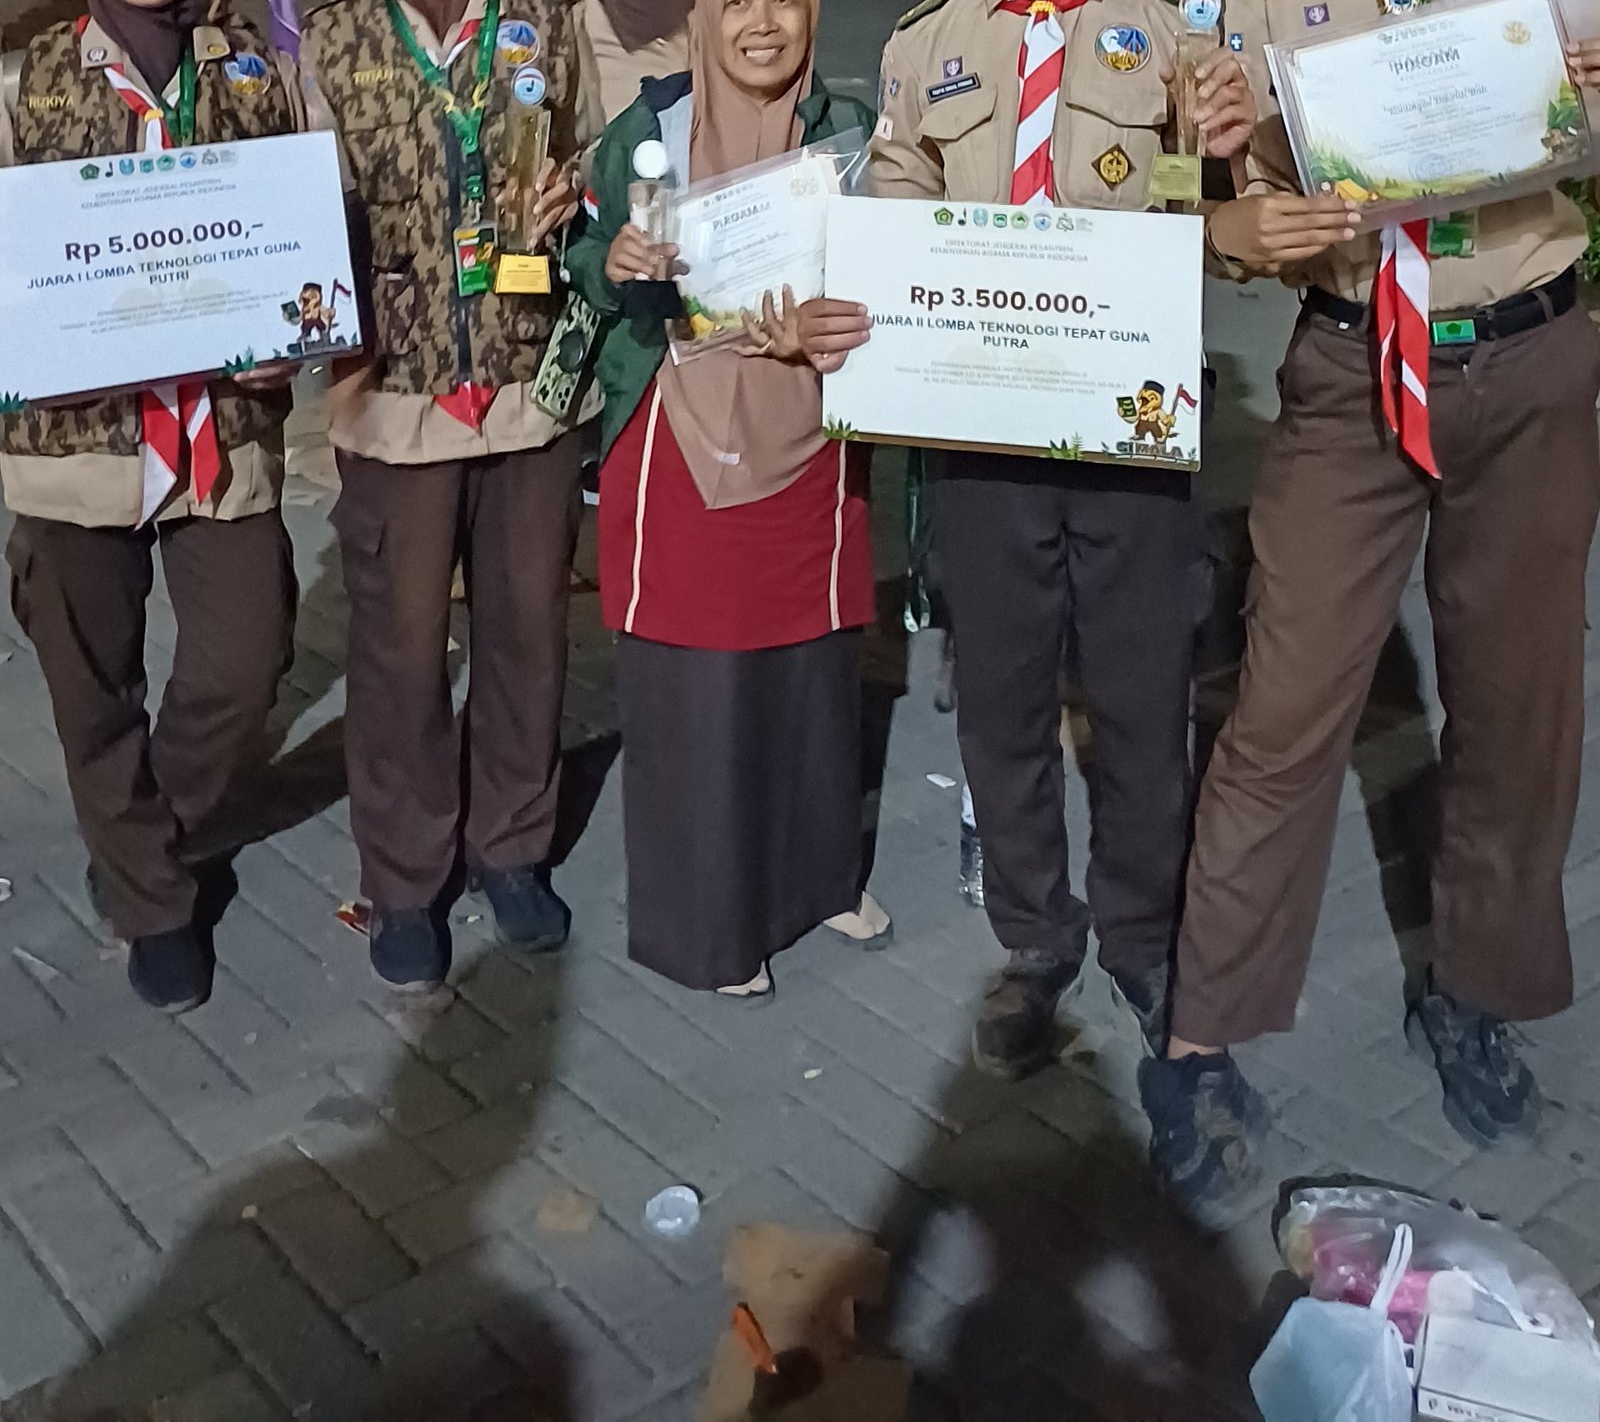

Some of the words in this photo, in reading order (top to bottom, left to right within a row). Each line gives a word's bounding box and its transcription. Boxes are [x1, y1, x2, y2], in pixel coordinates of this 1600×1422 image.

[26, 273, 75, 290] JUARA
[85, 264, 136, 282] LOMBA
[138, 252, 217, 273] TEKNOLOGI
[220, 246, 260, 262] TEPAT
[263, 240, 301, 255] GUNA
[64, 242, 101, 265] Rp
[149, 270, 190, 285] PUTRI
[910, 285, 945, 312] Rp
[916, 316, 924, 328] II
[927, 316, 976, 331] LOMBA
[978, 321, 1060, 337] TEKNOLOGI
[1063, 326, 1106, 341] TEPAT
[1109, 330, 1151, 344] GUNA
[983, 335, 1030, 349] PUTRA
